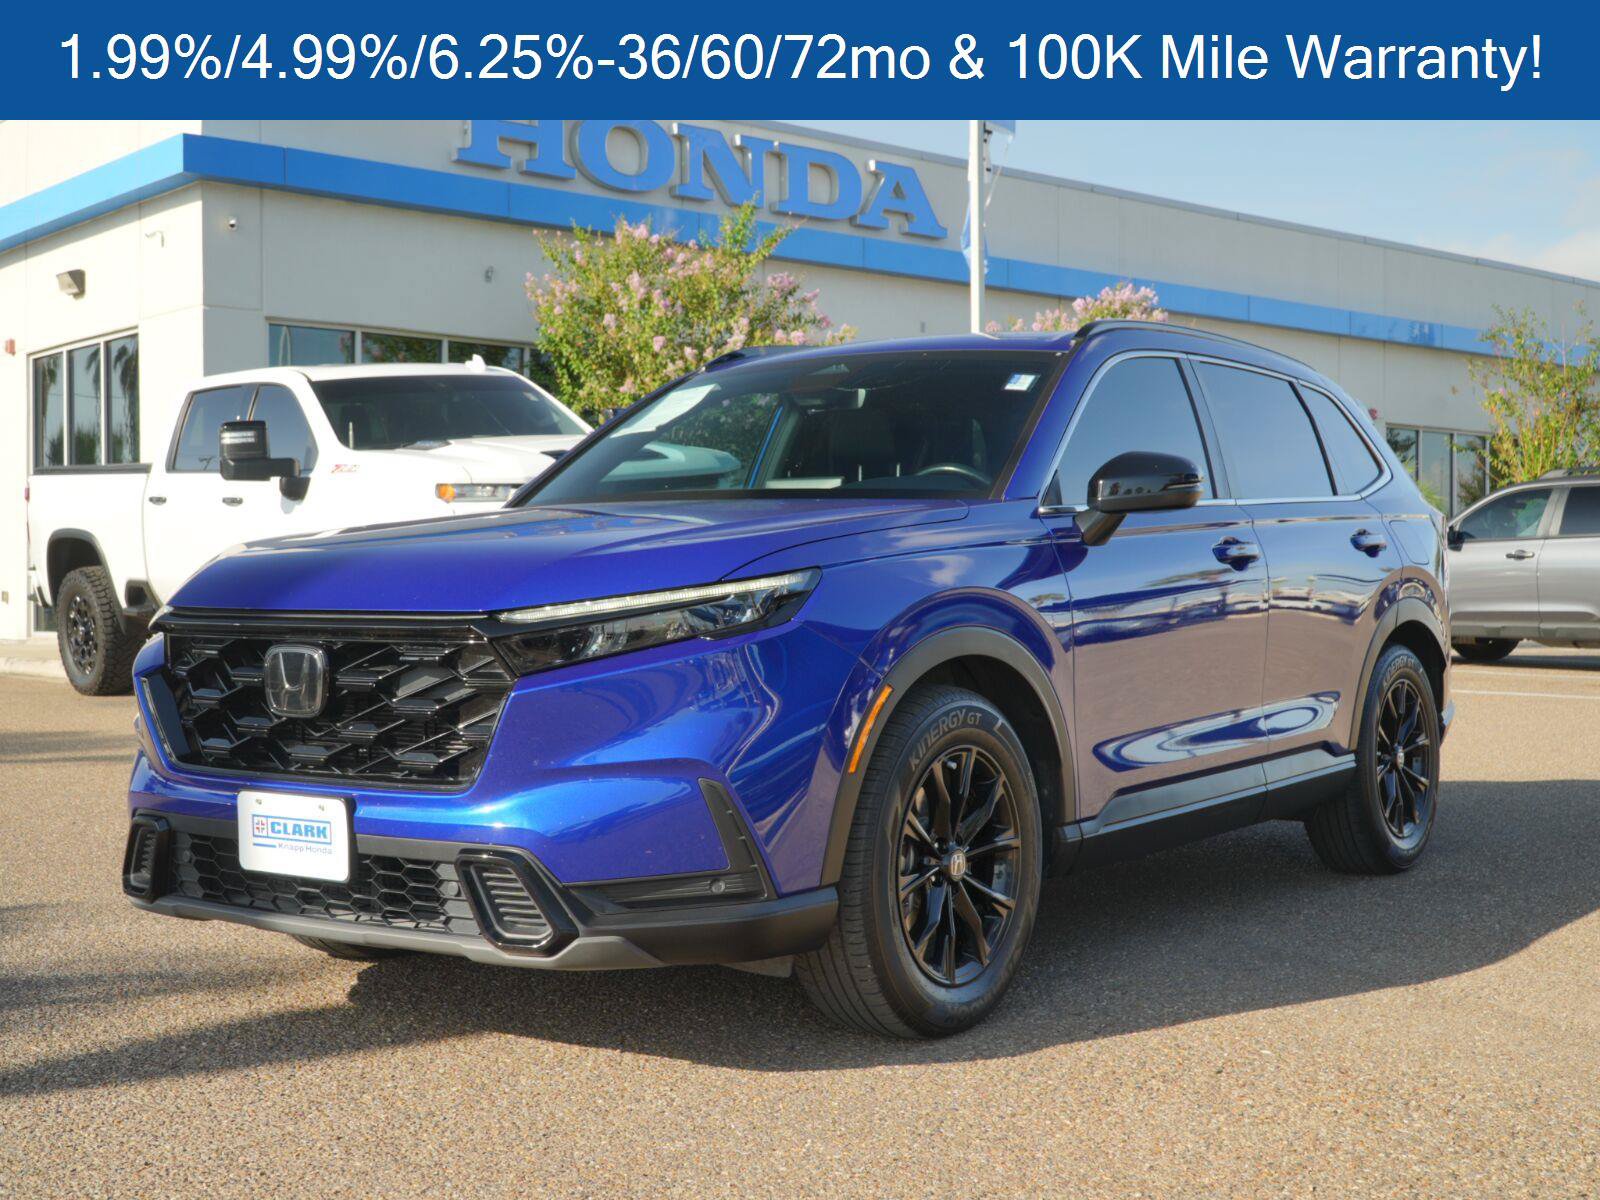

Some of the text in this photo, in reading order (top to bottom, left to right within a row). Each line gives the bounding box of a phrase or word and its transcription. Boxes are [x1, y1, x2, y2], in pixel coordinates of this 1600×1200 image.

[452, 120, 948, 239] HONDA
[909, 708, 982, 771] KINERGY GT
[270, 821, 328, 839] CLARK
[278, 843, 333, 855] Knapp Honda
